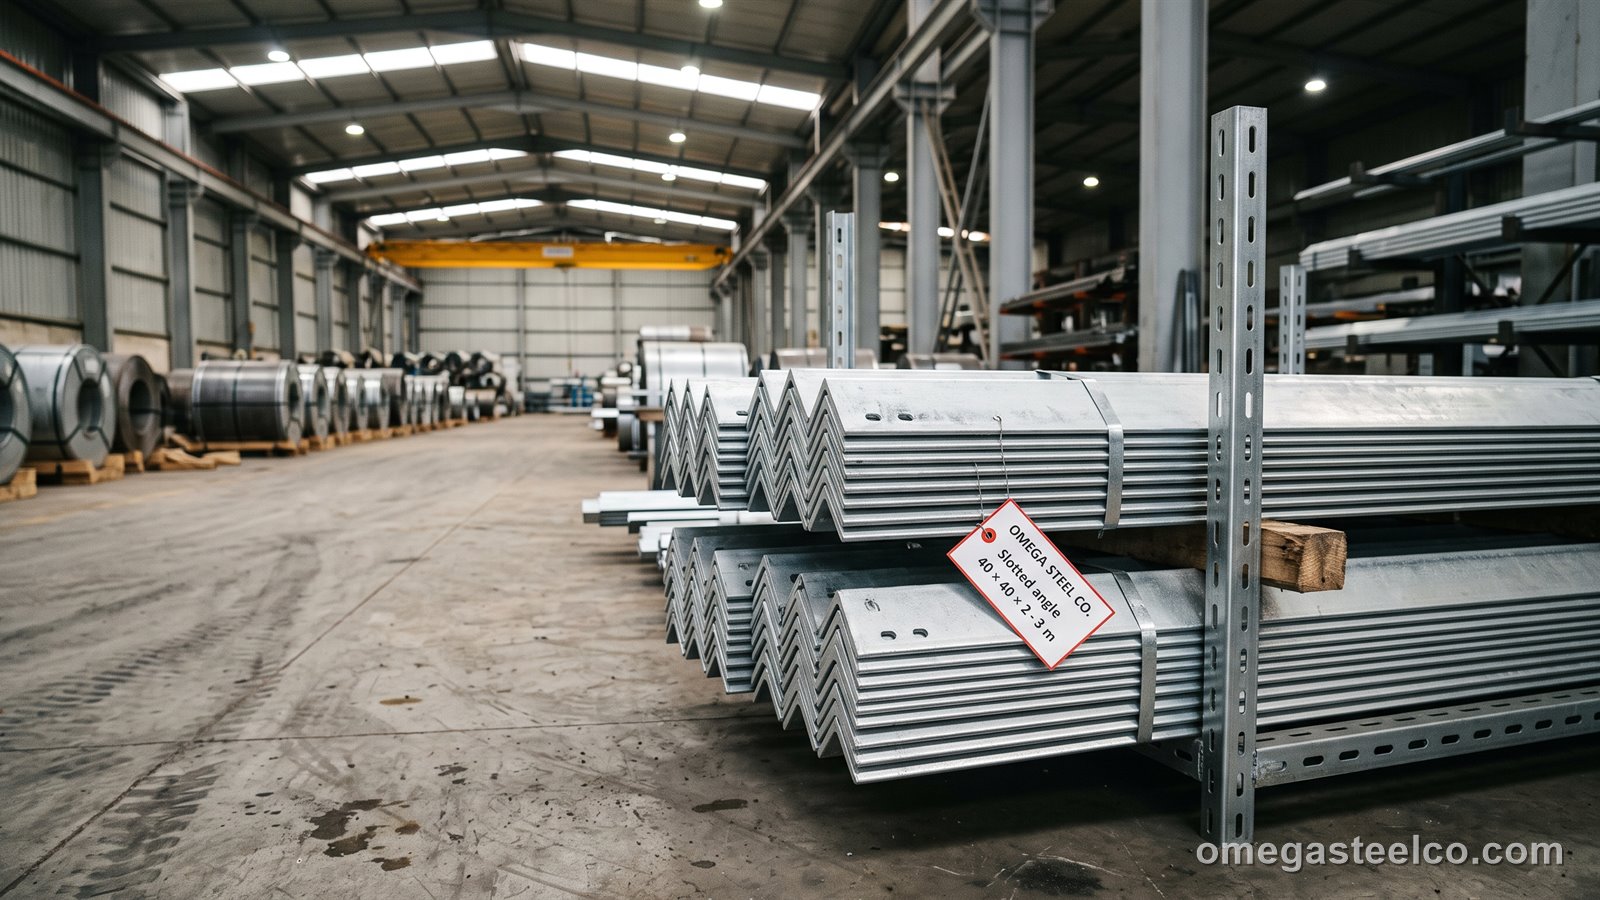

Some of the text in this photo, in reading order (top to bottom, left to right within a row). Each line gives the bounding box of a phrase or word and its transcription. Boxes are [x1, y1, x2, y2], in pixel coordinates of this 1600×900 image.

[978, 557, 993, 573] 40
[999, 581, 1015, 597] 40
[1021, 604, 1031, 615] 2
[1034, 618, 1045, 629] 3
[1042, 629, 1056, 642] m
[997, 549, 1061, 618] Slotted angle
[1009, 524, 1091, 617] OMEGA STEEL CO.
